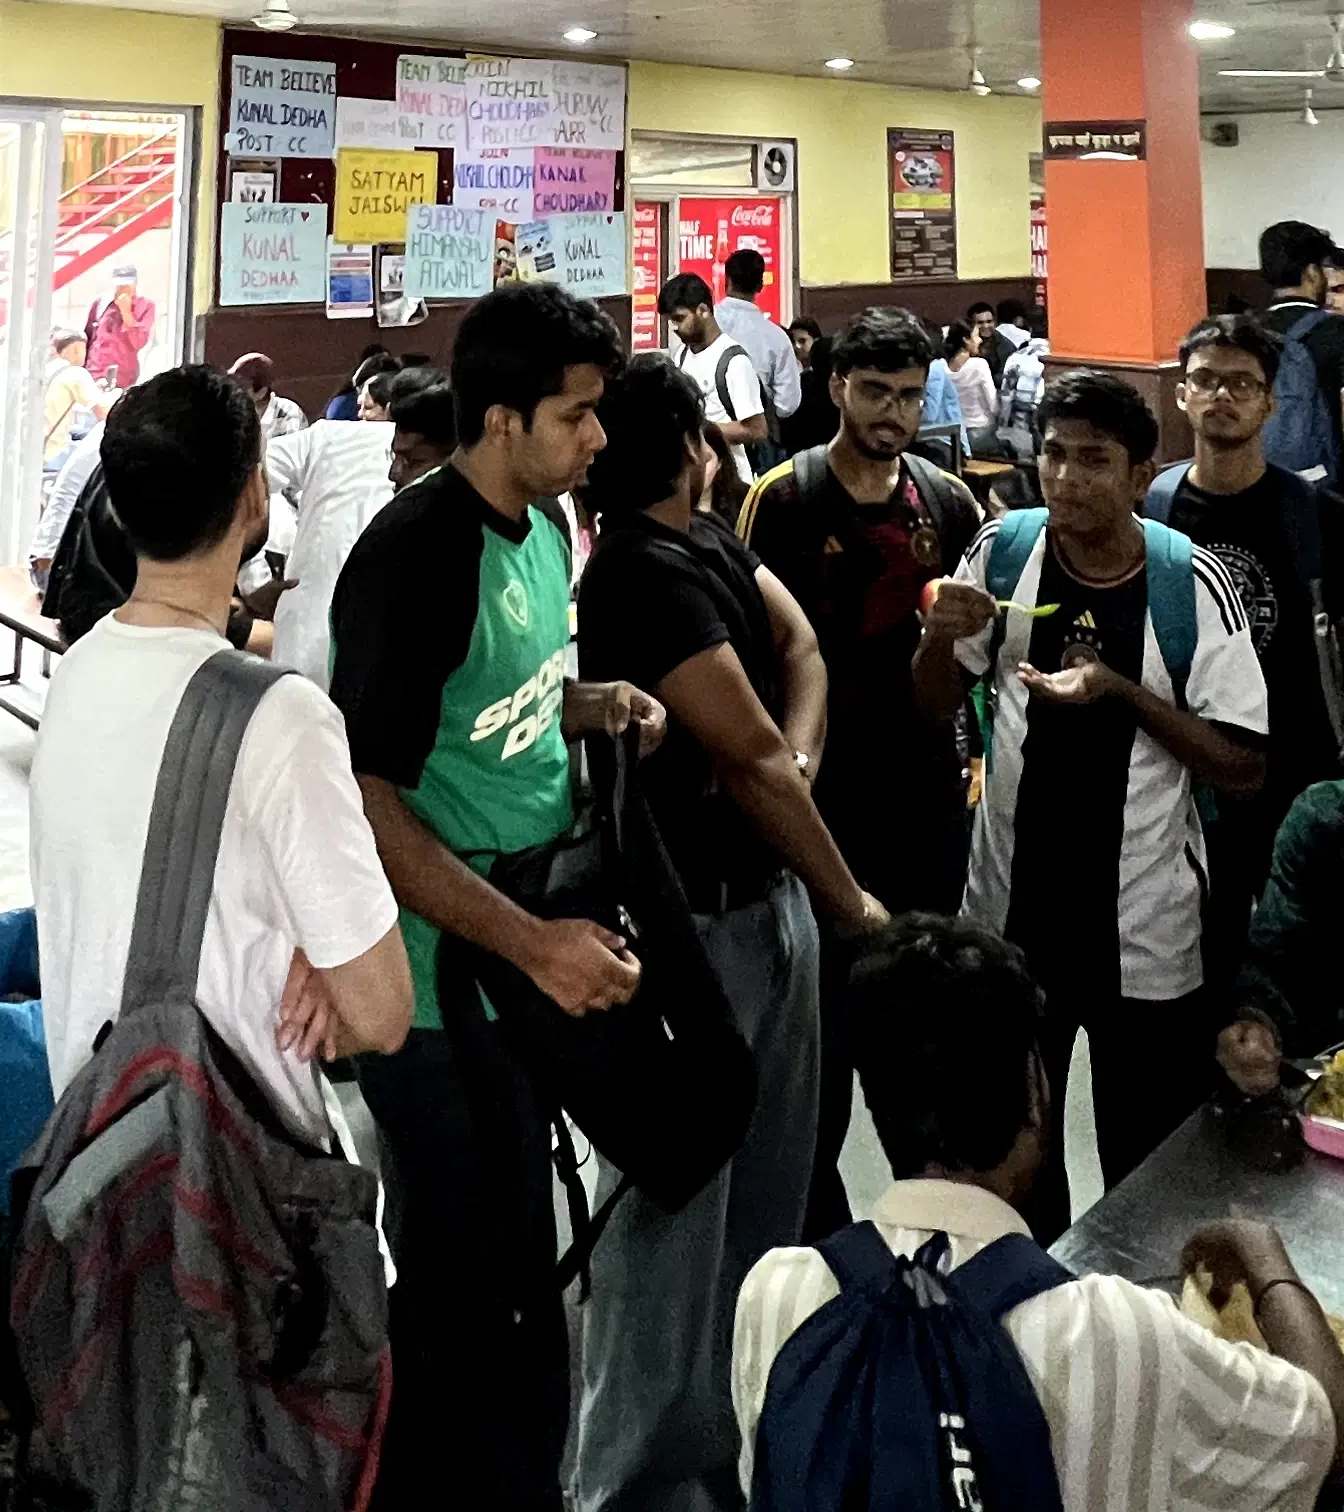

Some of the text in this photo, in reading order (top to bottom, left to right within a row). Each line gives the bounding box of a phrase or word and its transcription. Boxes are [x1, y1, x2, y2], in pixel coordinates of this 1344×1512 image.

[235, 64, 336, 96] TEAM BELIEVE
[398, 58, 431, 82] TEAM
[479, 80, 549, 99] NIKHIL
[280, 103, 328, 131] DEDHA
[236, 127, 308, 153] POST CC
[350, 169, 425, 194] SATYAM
[679, 220, 701, 235] HALF
[241, 232, 301, 263] KUNAL
[564, 232, 602, 262] KUNAL
[679, 235, 714, 260] TIME
[419, 260, 483, 290] ATWAL
[469, 648, 564, 742] SPOR
